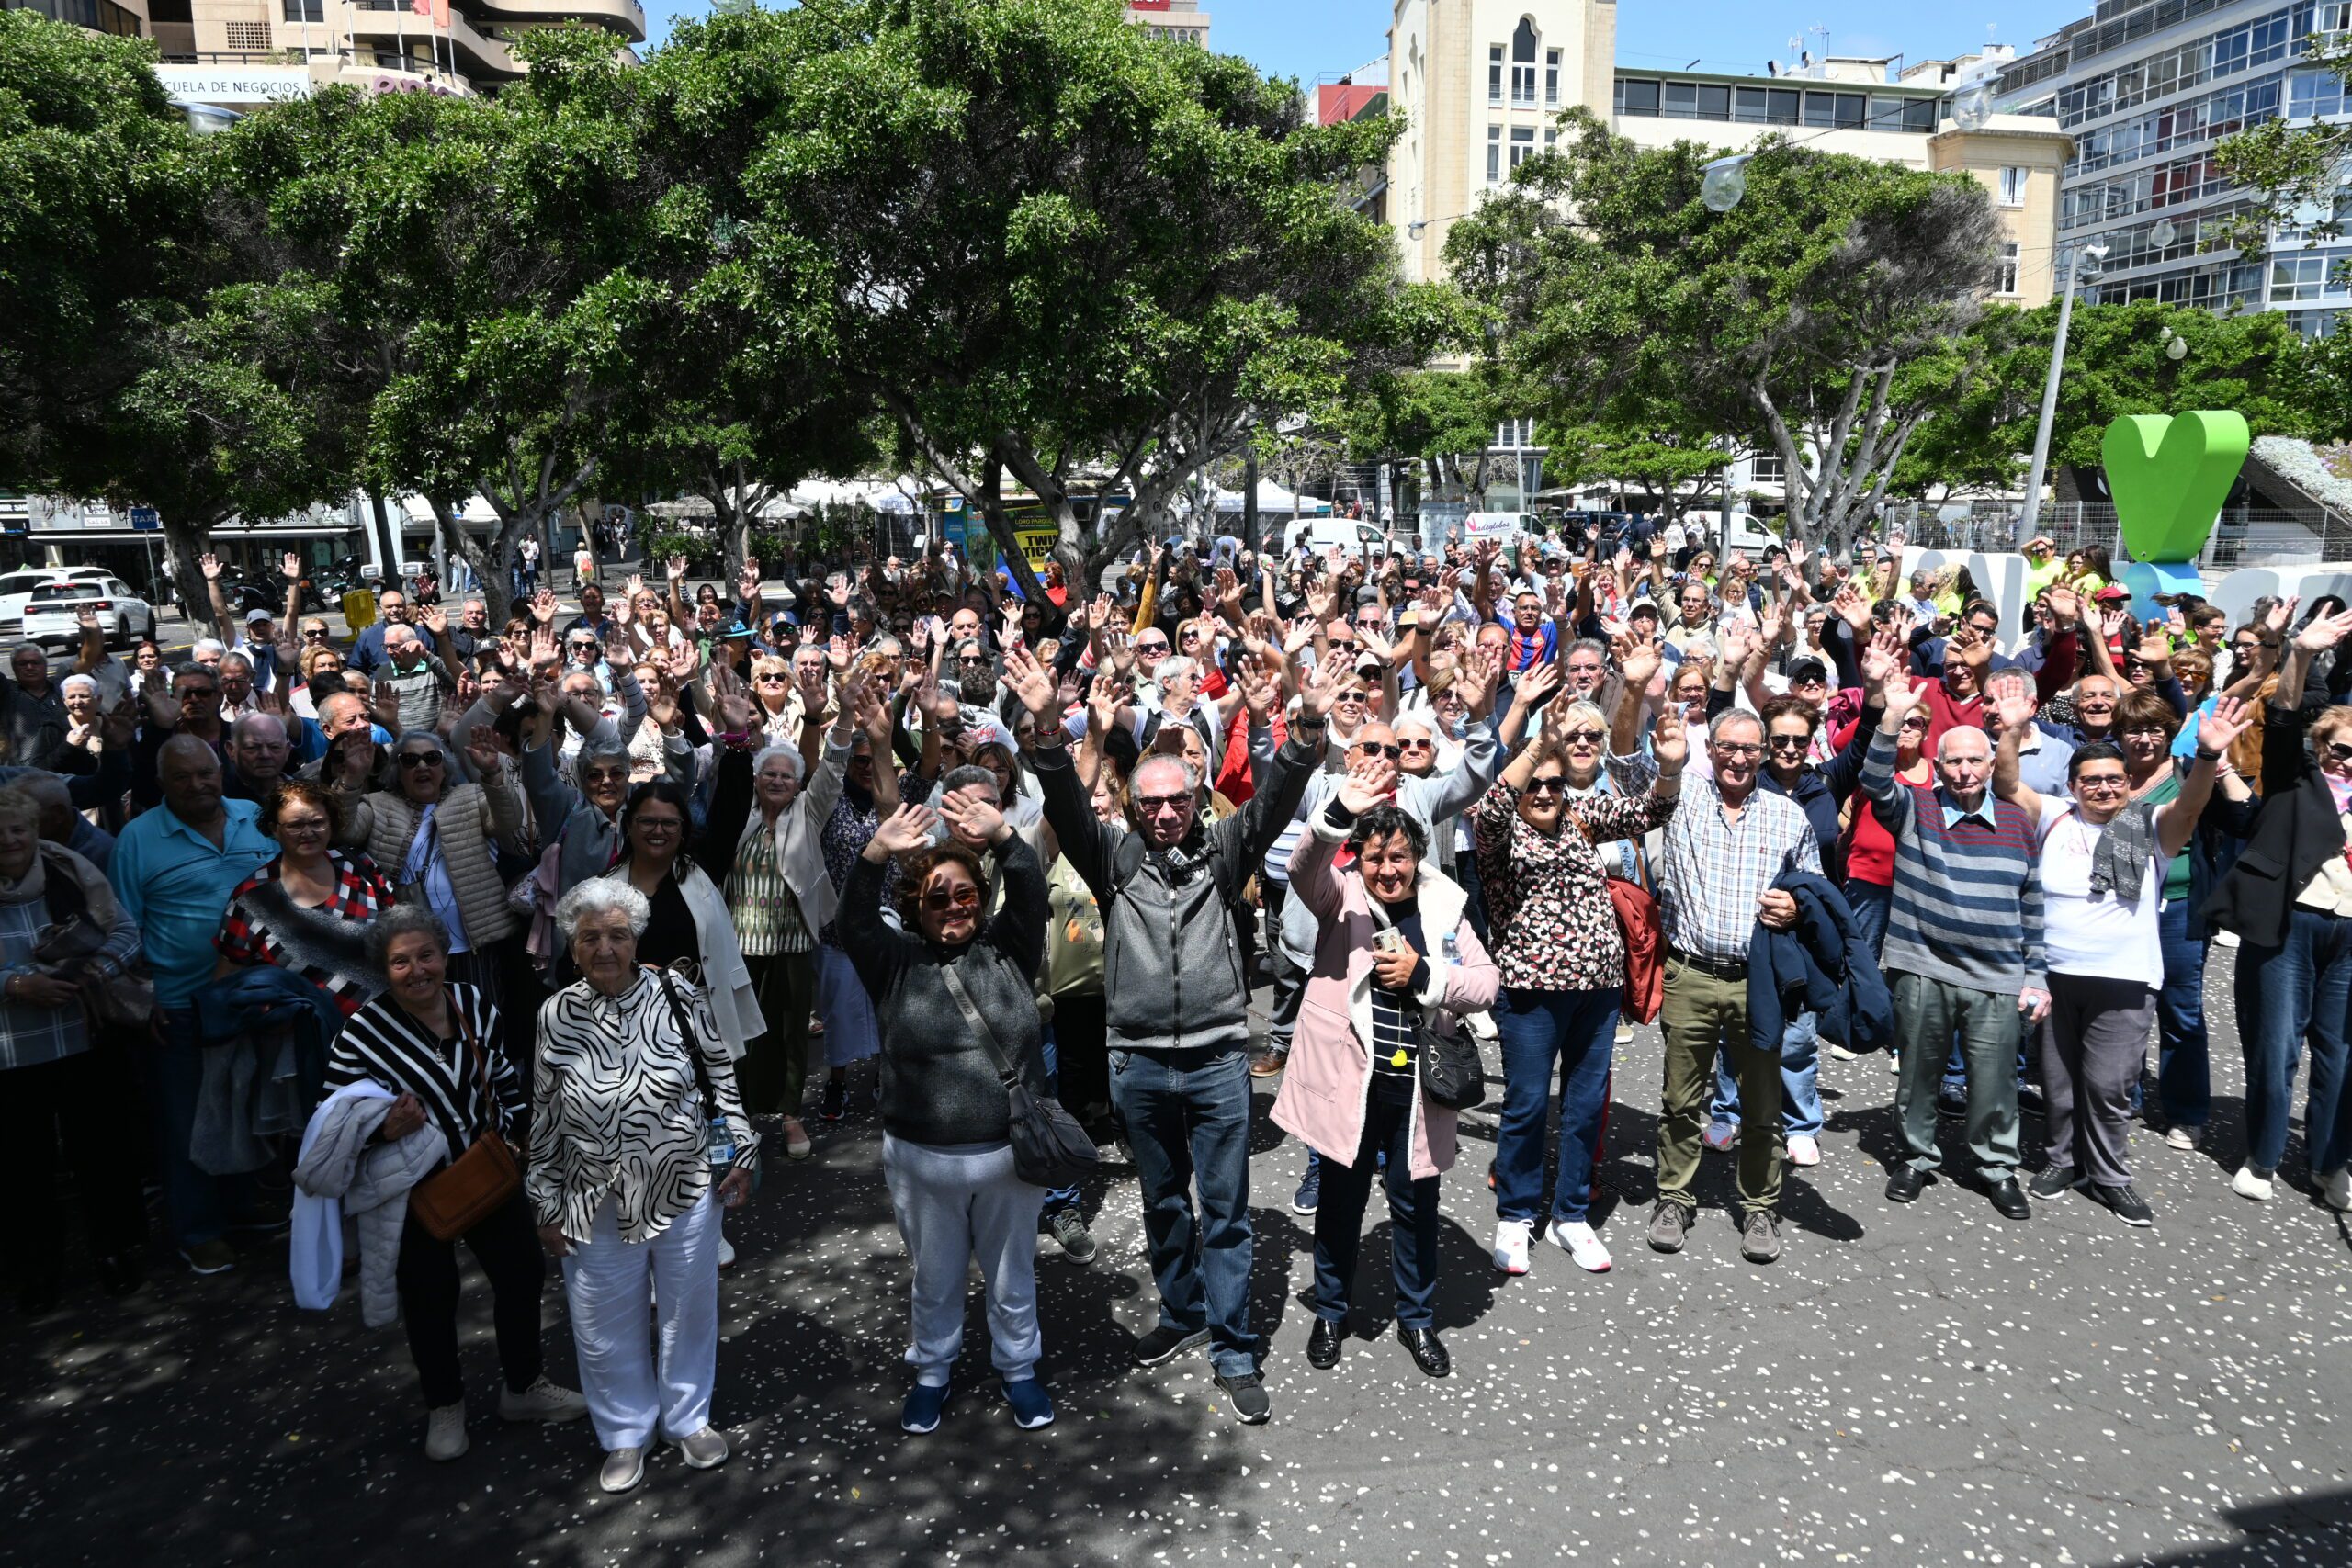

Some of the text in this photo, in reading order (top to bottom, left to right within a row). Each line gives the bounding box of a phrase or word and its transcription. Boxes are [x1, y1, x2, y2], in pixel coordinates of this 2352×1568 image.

[164, 81, 300, 93] CUELA DE NEGOCIOS
[133, 513, 156, 523] TAXI
[1466, 515, 1510, 533] Vadeglobos
[1023, 546, 1053, 558] TICK
